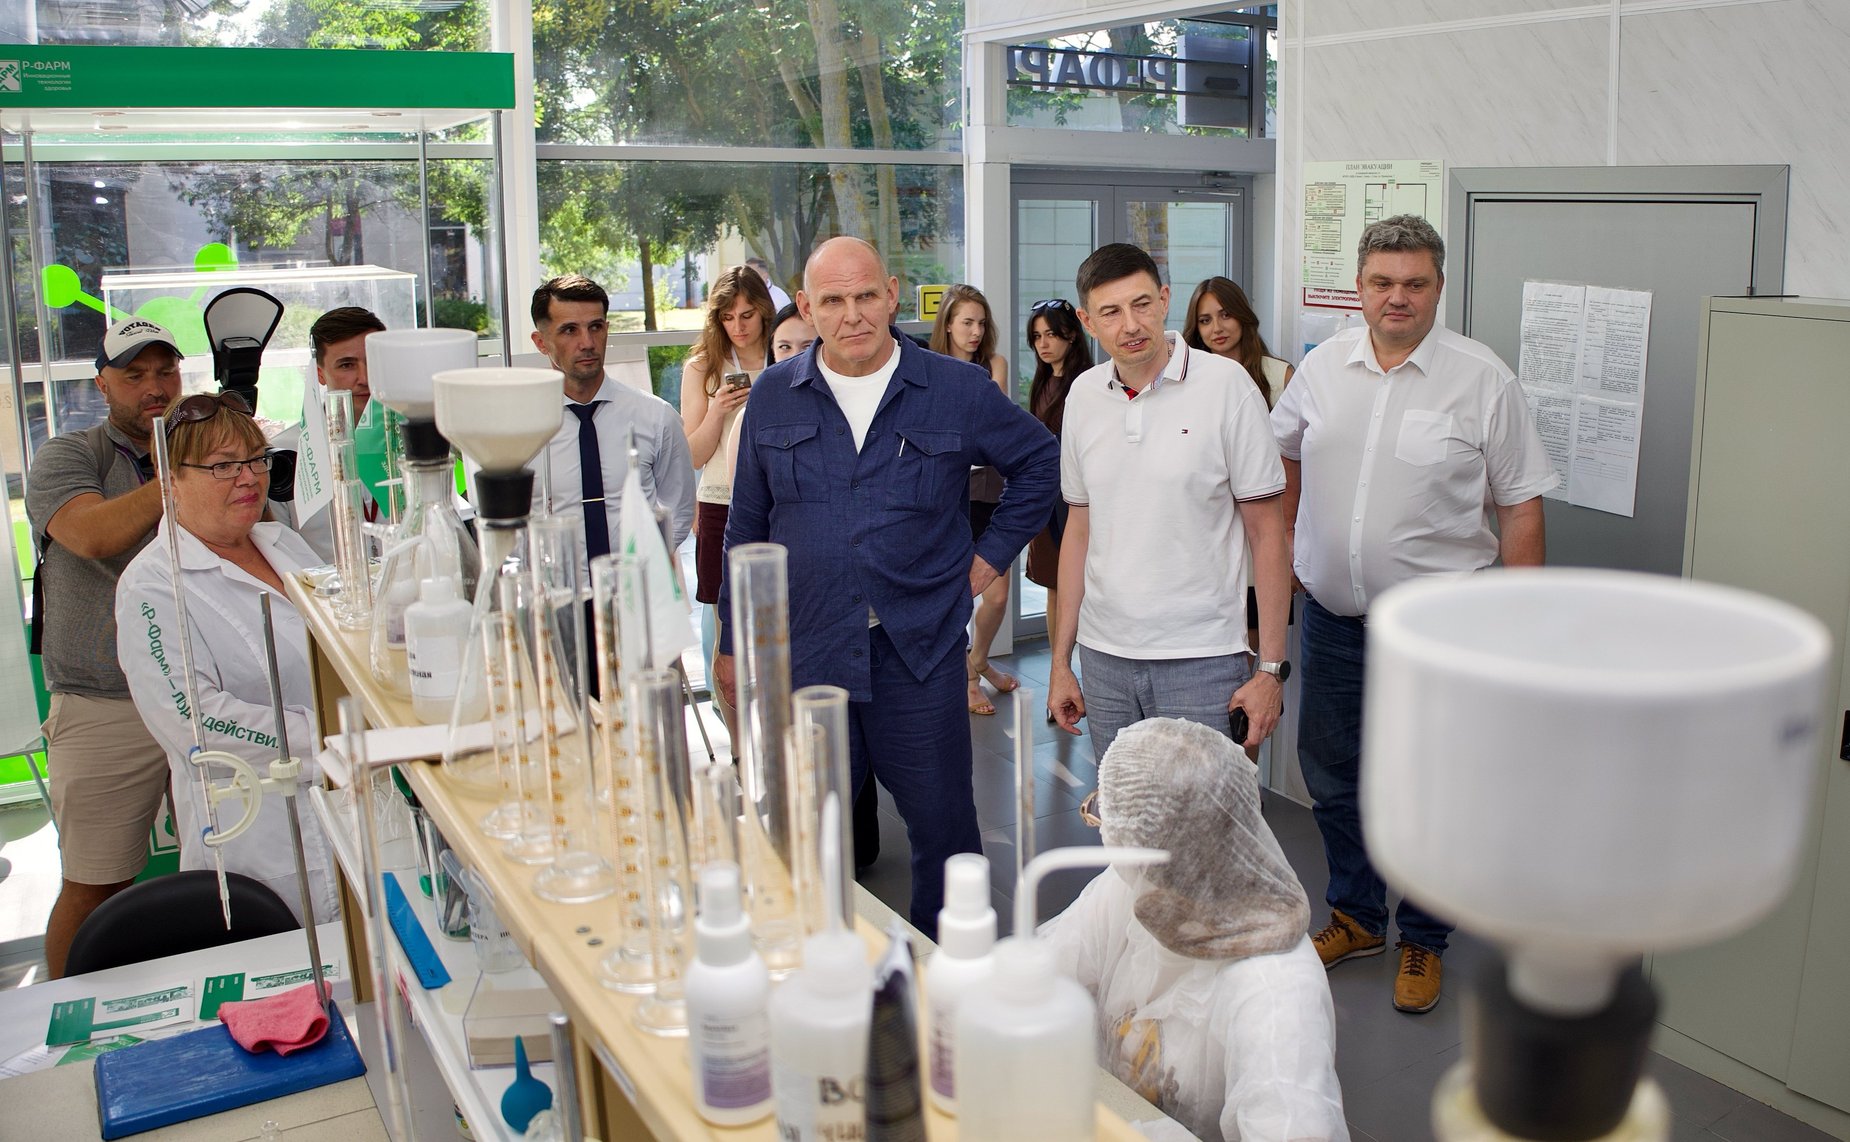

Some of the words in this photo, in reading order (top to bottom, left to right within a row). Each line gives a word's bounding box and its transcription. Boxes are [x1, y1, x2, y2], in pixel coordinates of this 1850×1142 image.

[22, 61, 71, 71] Р-ФАРМ
[302, 431, 322, 495] Р-ФАРМ
[203, 715, 280, 749] действи
